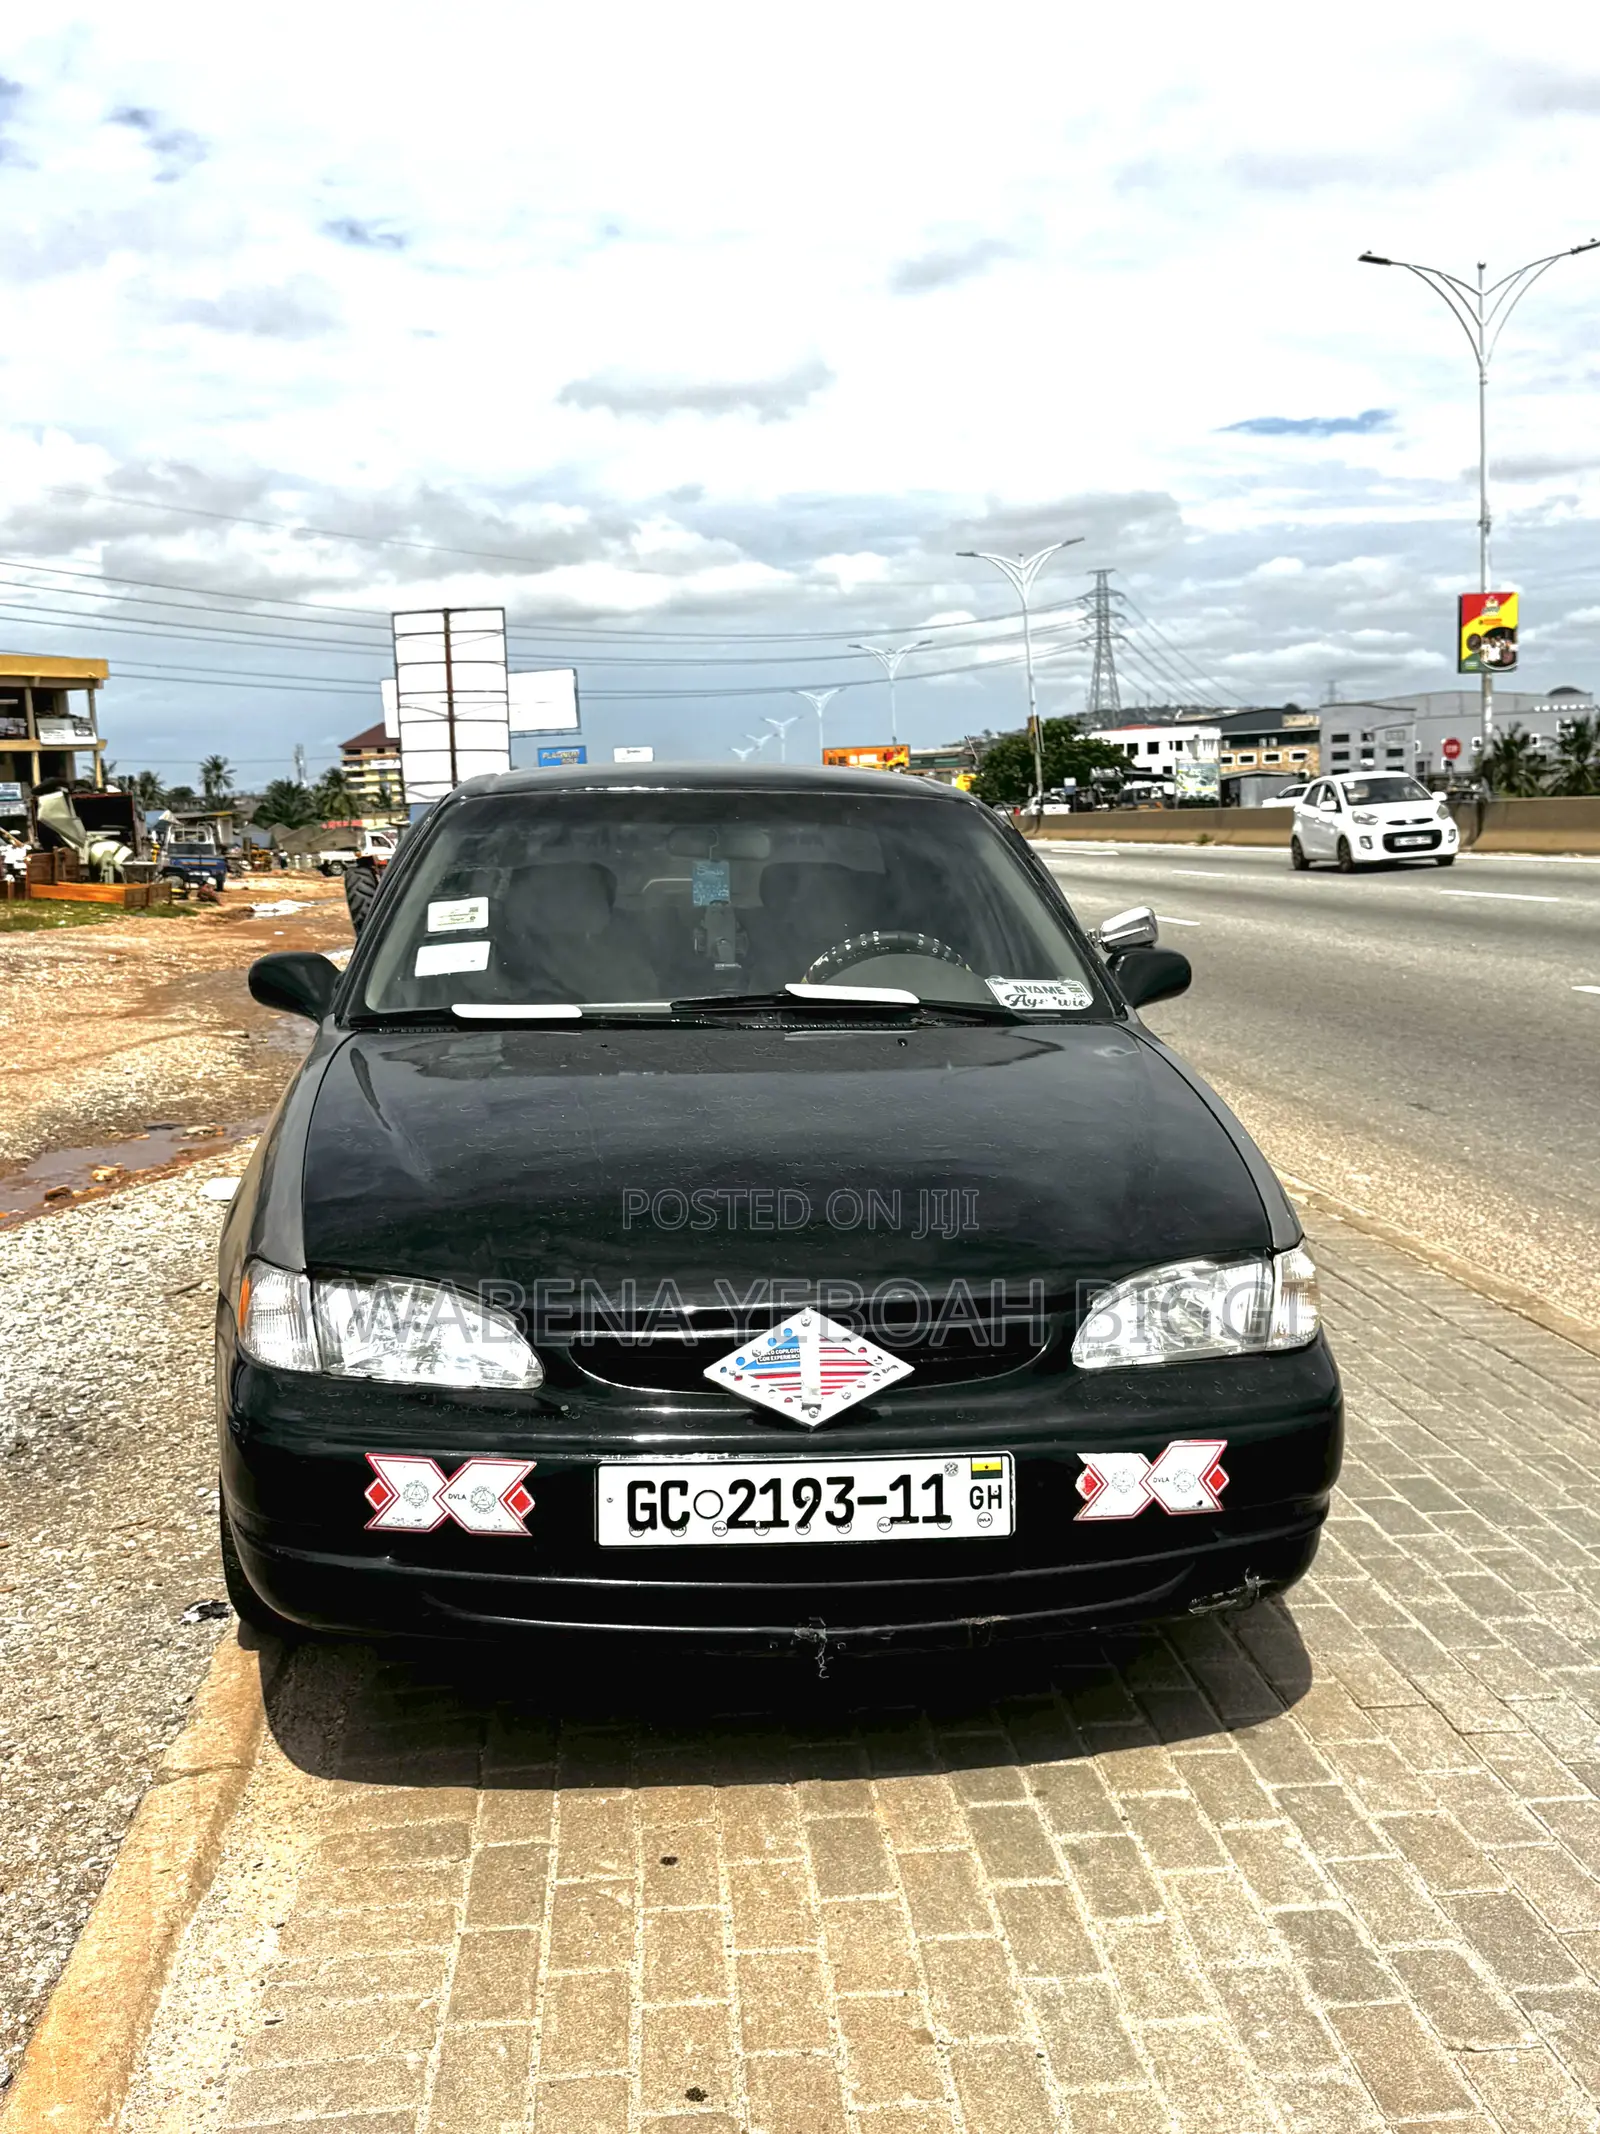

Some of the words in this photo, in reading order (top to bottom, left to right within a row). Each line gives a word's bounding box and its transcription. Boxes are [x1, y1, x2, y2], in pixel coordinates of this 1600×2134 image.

[1013, 985, 1066, 995] NYAME
[627, 1480, 691, 1530] GC
[727, 1473, 952, 1529] 2193-11
[969, 1484, 1002, 1510] GH
